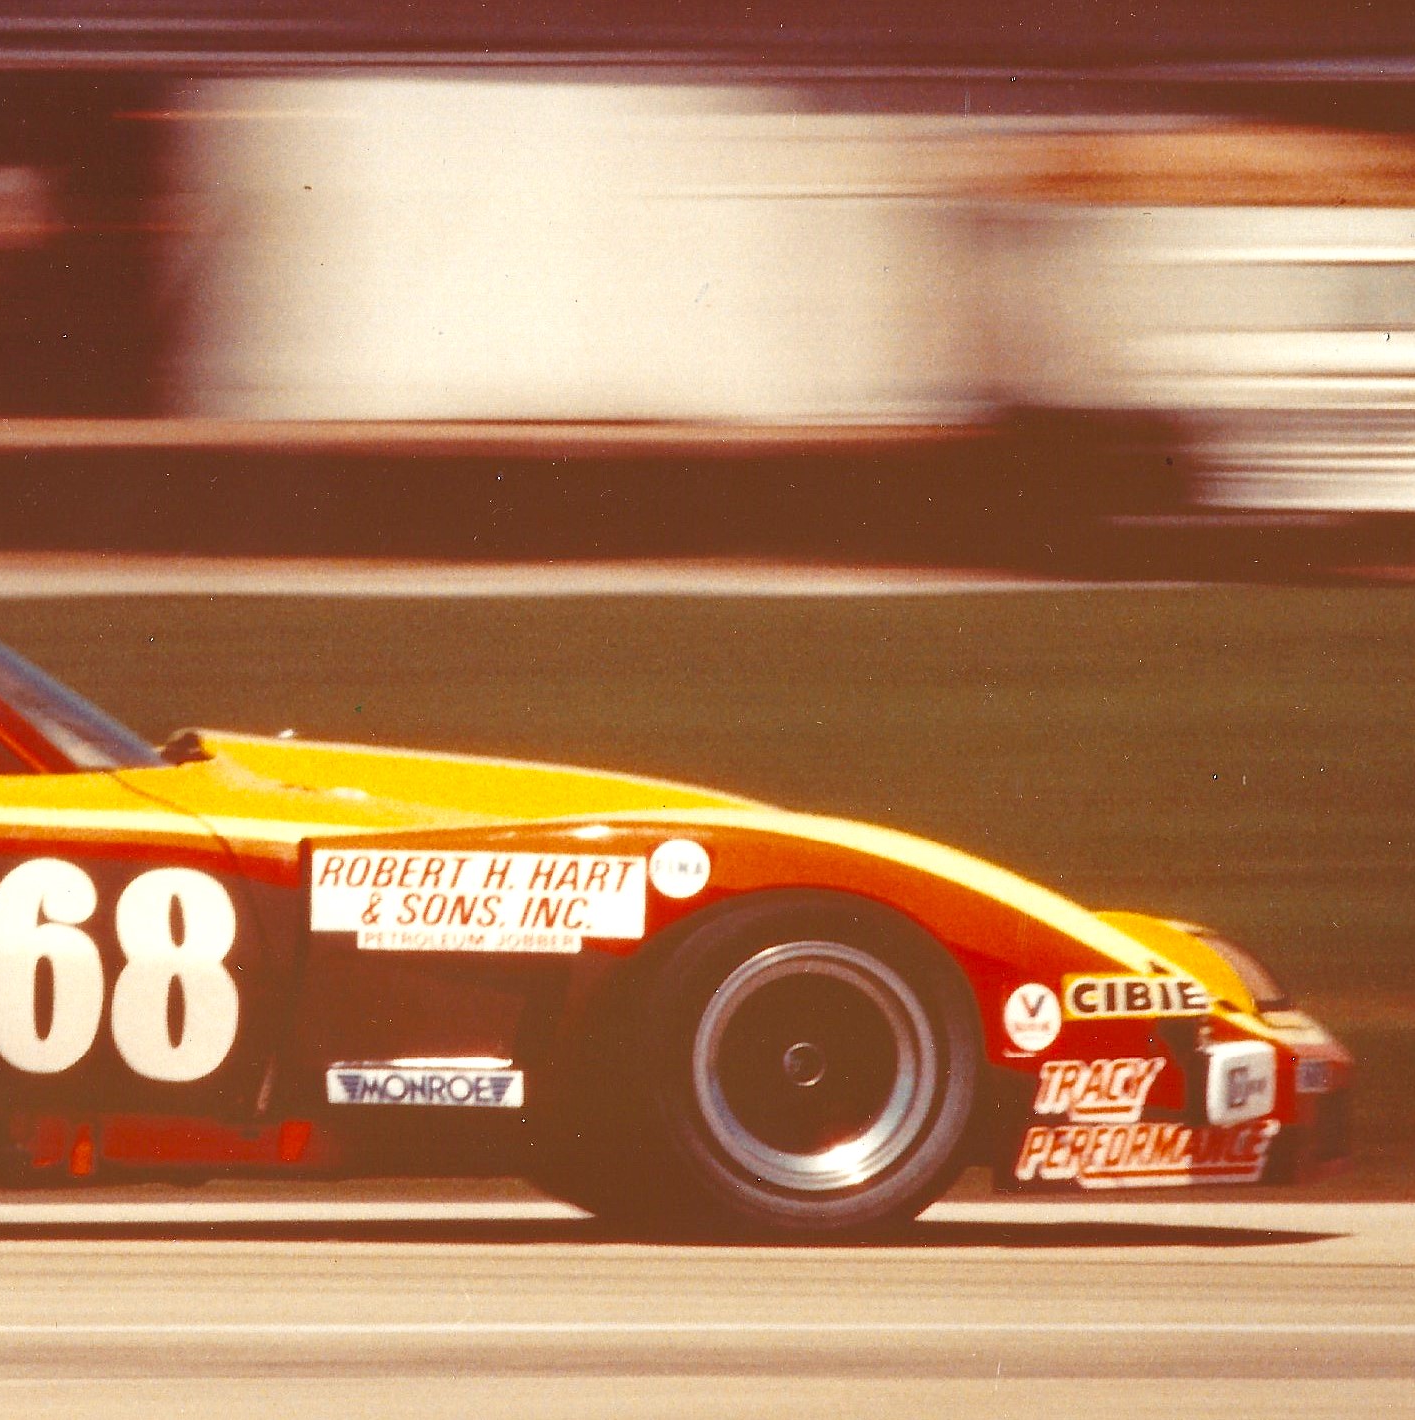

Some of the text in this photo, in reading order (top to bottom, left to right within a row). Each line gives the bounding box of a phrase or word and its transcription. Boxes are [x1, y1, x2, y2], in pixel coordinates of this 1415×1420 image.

[318, 856, 635, 893] ROBERT H. HART
[361, 892, 383, 925] &
[519, 898, 592, 930] INC.
[360, 1074, 494, 1103] MONROE
[1036, 1058, 1166, 1113] TRACY
